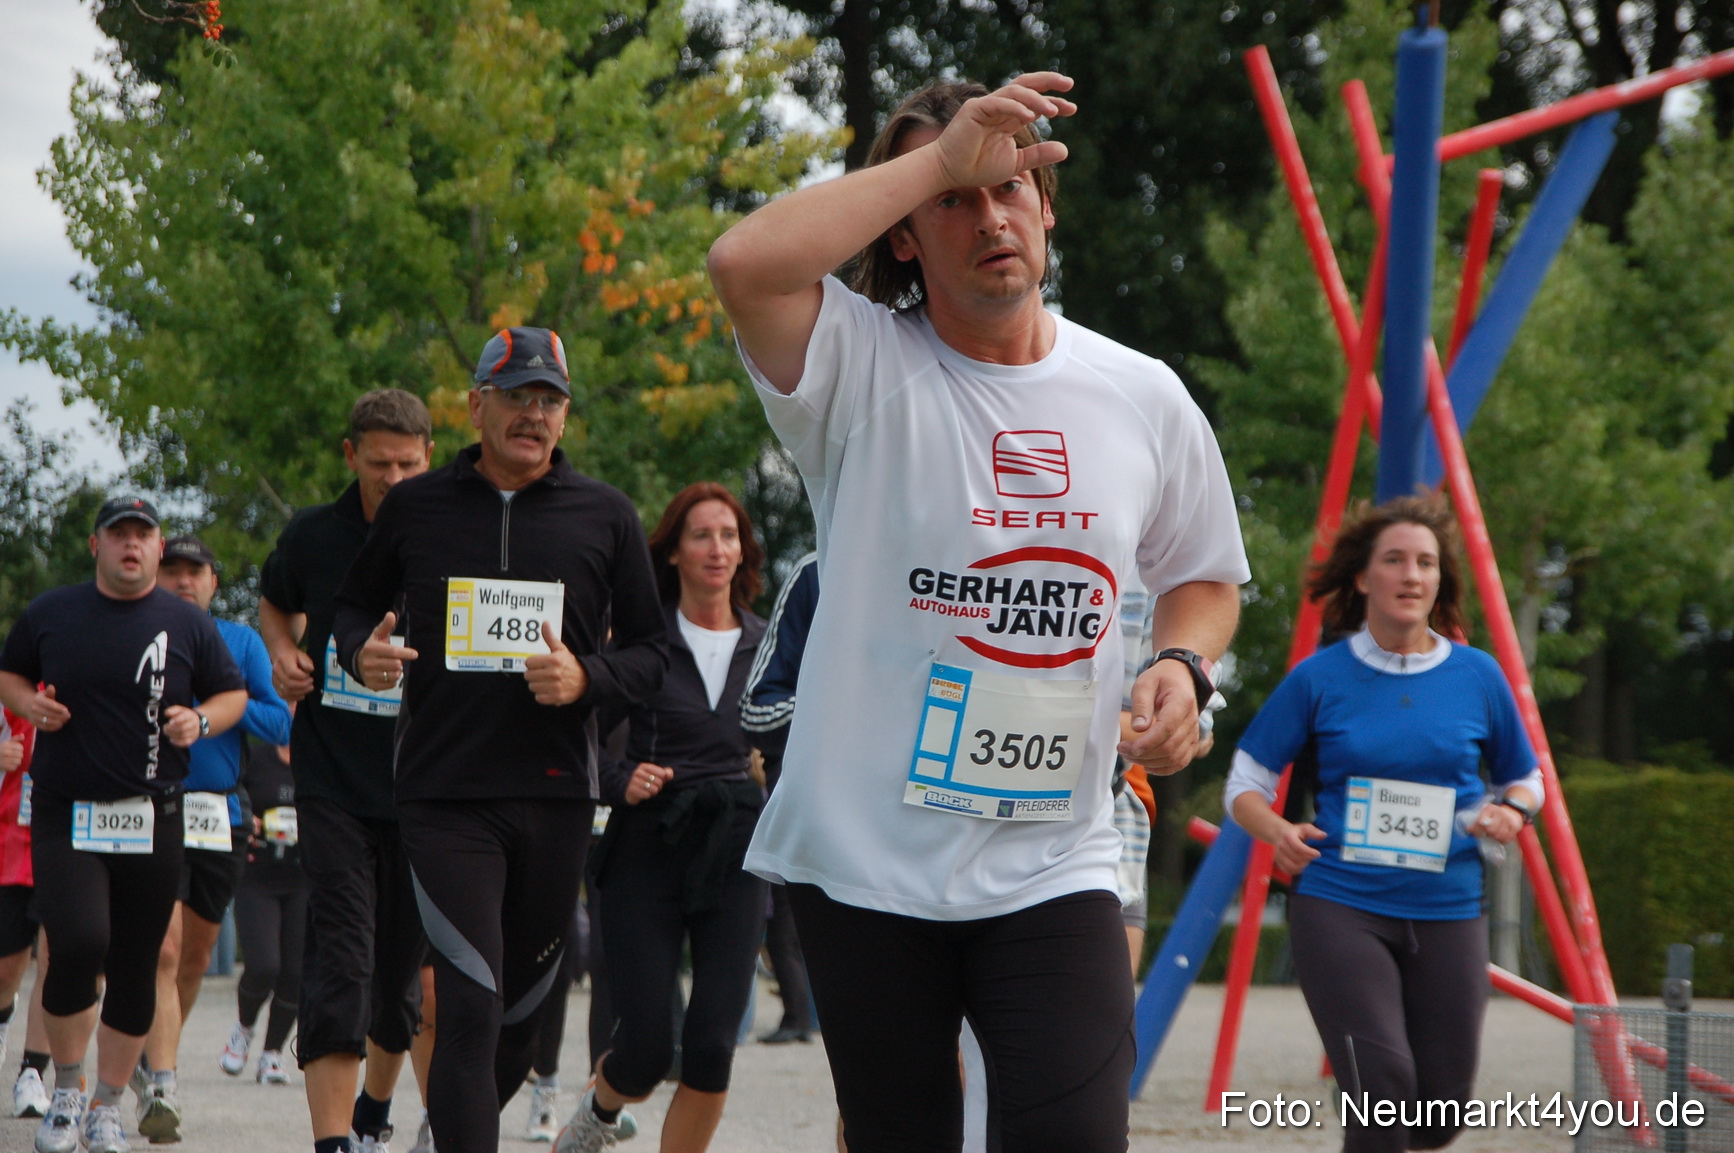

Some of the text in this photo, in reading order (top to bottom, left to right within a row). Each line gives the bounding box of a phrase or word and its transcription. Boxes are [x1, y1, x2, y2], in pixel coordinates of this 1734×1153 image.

[972, 507, 1099, 530] SEAT
[479, 587, 545, 612] Wolfgang
[908, 567, 1104, 609] GERHART &
[909, 597, 991, 619] AUTOHAUS
[487, 616, 540, 643] 488
[986, 606, 1101, 640] JÄNIG
[969, 728, 1069, 771] 3505
[924, 790, 973, 809] BOCK
[1016, 799, 1070, 812] PFLEIDERER
[97, 812, 144, 830] 3029
[188, 815, 220, 832] 247
[1378, 812, 1440, 841] 3438
